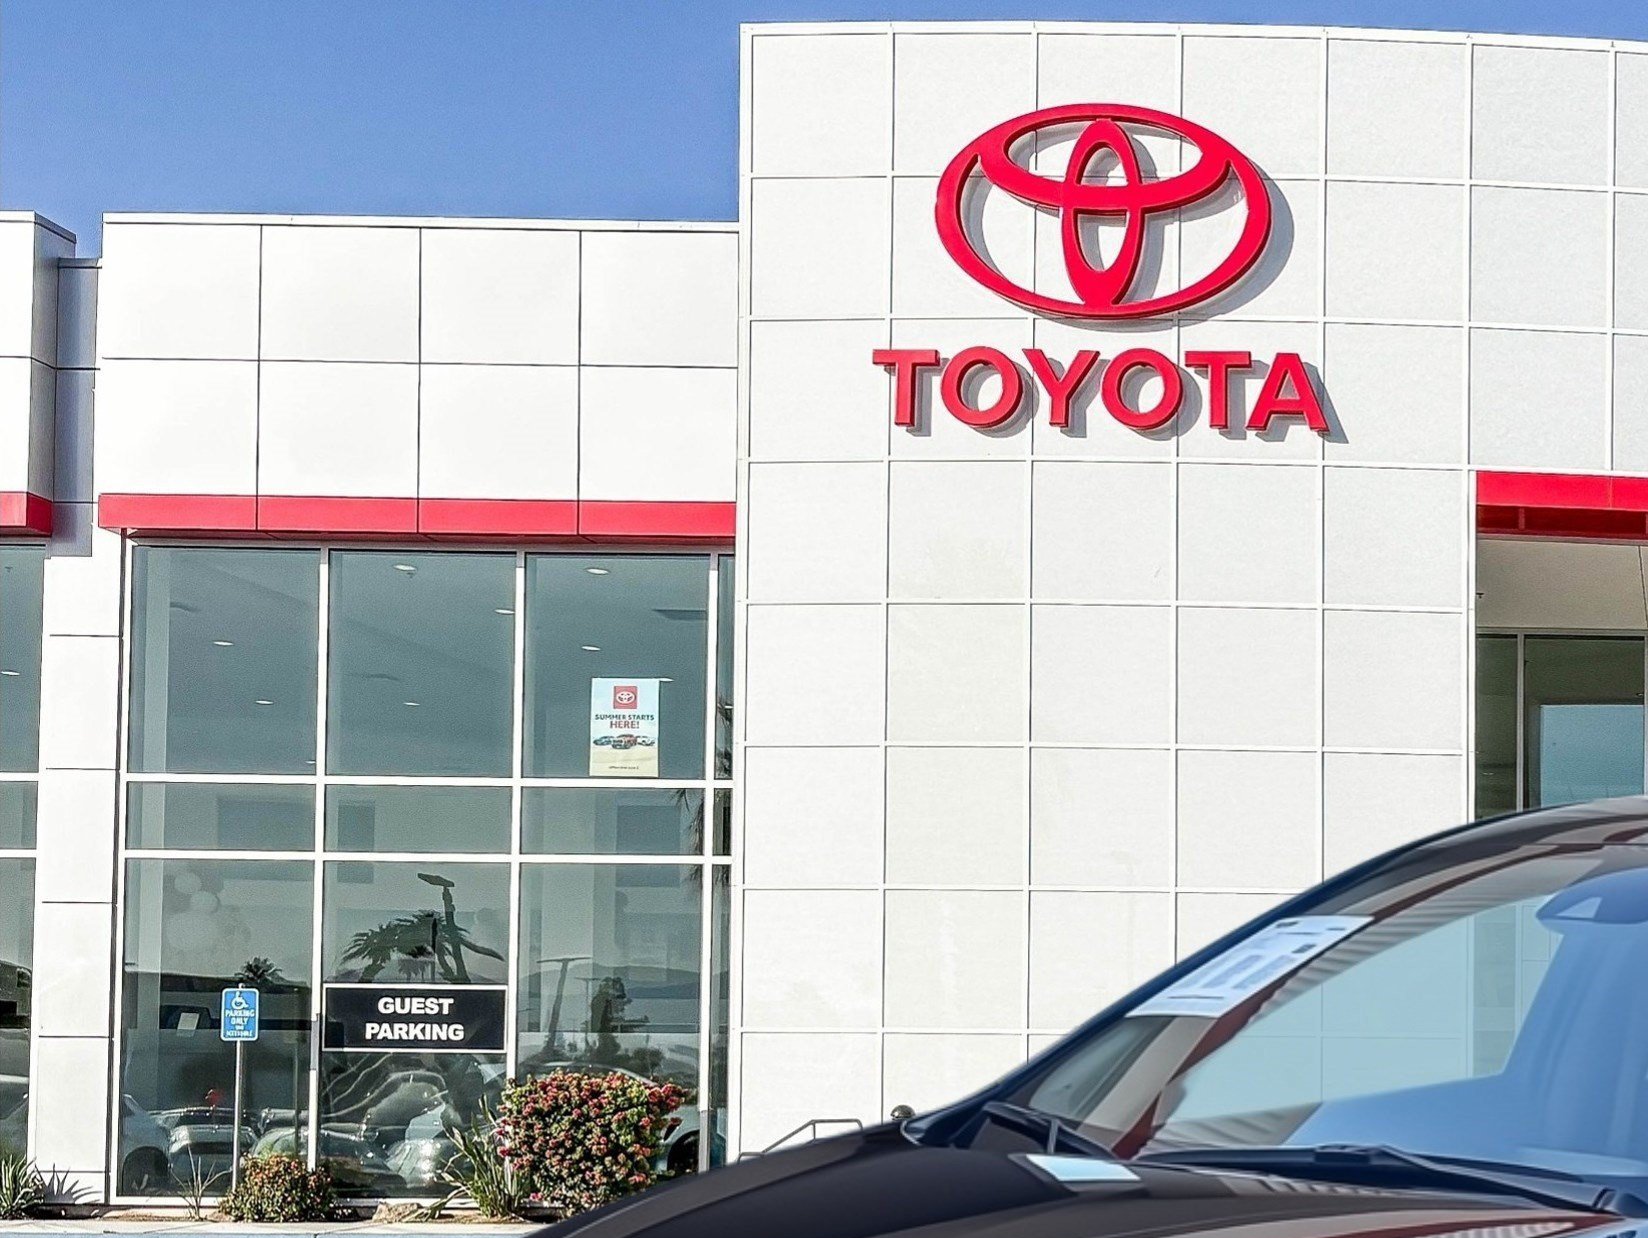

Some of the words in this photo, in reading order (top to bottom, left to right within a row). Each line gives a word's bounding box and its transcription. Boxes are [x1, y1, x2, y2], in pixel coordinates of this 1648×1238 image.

[872, 345, 1331, 434] TOYOTA
[609, 720, 640, 729] HERE!
[377, 997, 455, 1015] GUEST
[364, 1022, 465, 1041] PARKING
